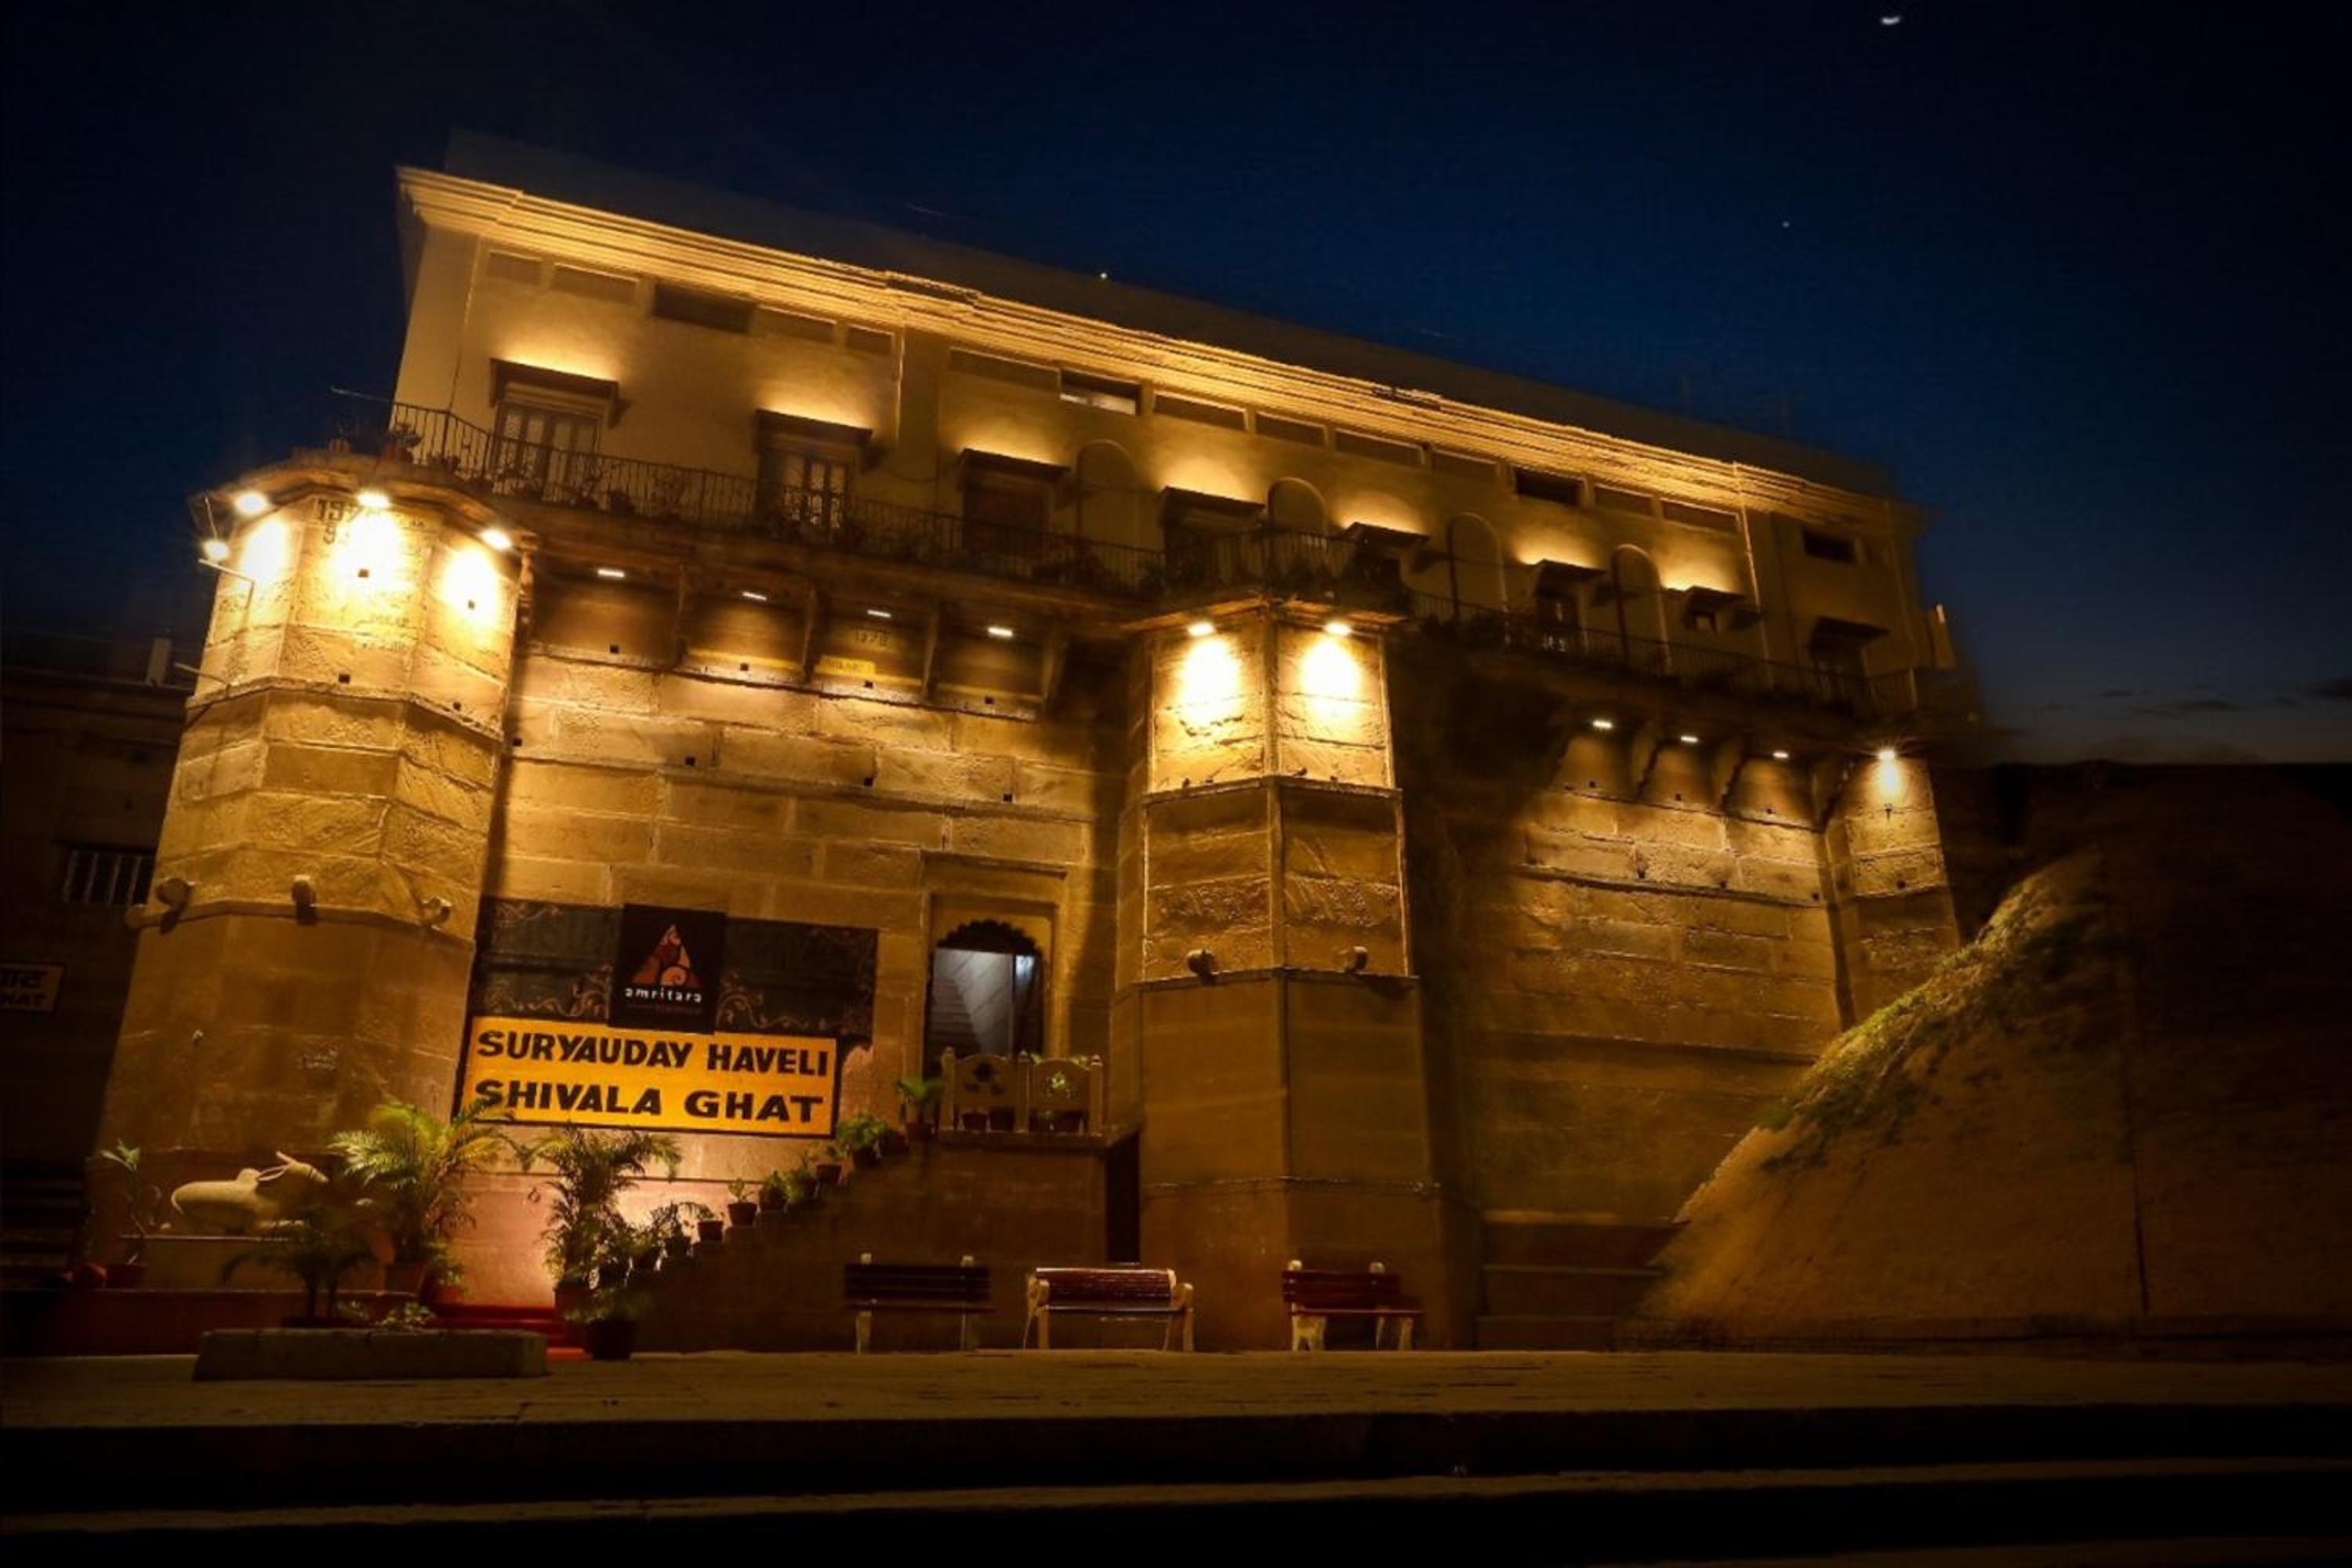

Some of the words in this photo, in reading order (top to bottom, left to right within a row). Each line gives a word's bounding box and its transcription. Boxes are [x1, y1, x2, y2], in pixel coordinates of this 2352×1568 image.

[624, 986, 702, 1004] amritara
[477, 1029, 693, 1069] SURYAUDAY
[707, 1044, 829, 1076] HAVELI
[474, 1079, 662, 1116] SHIVALA
[684, 1091, 824, 1123] GHAT
